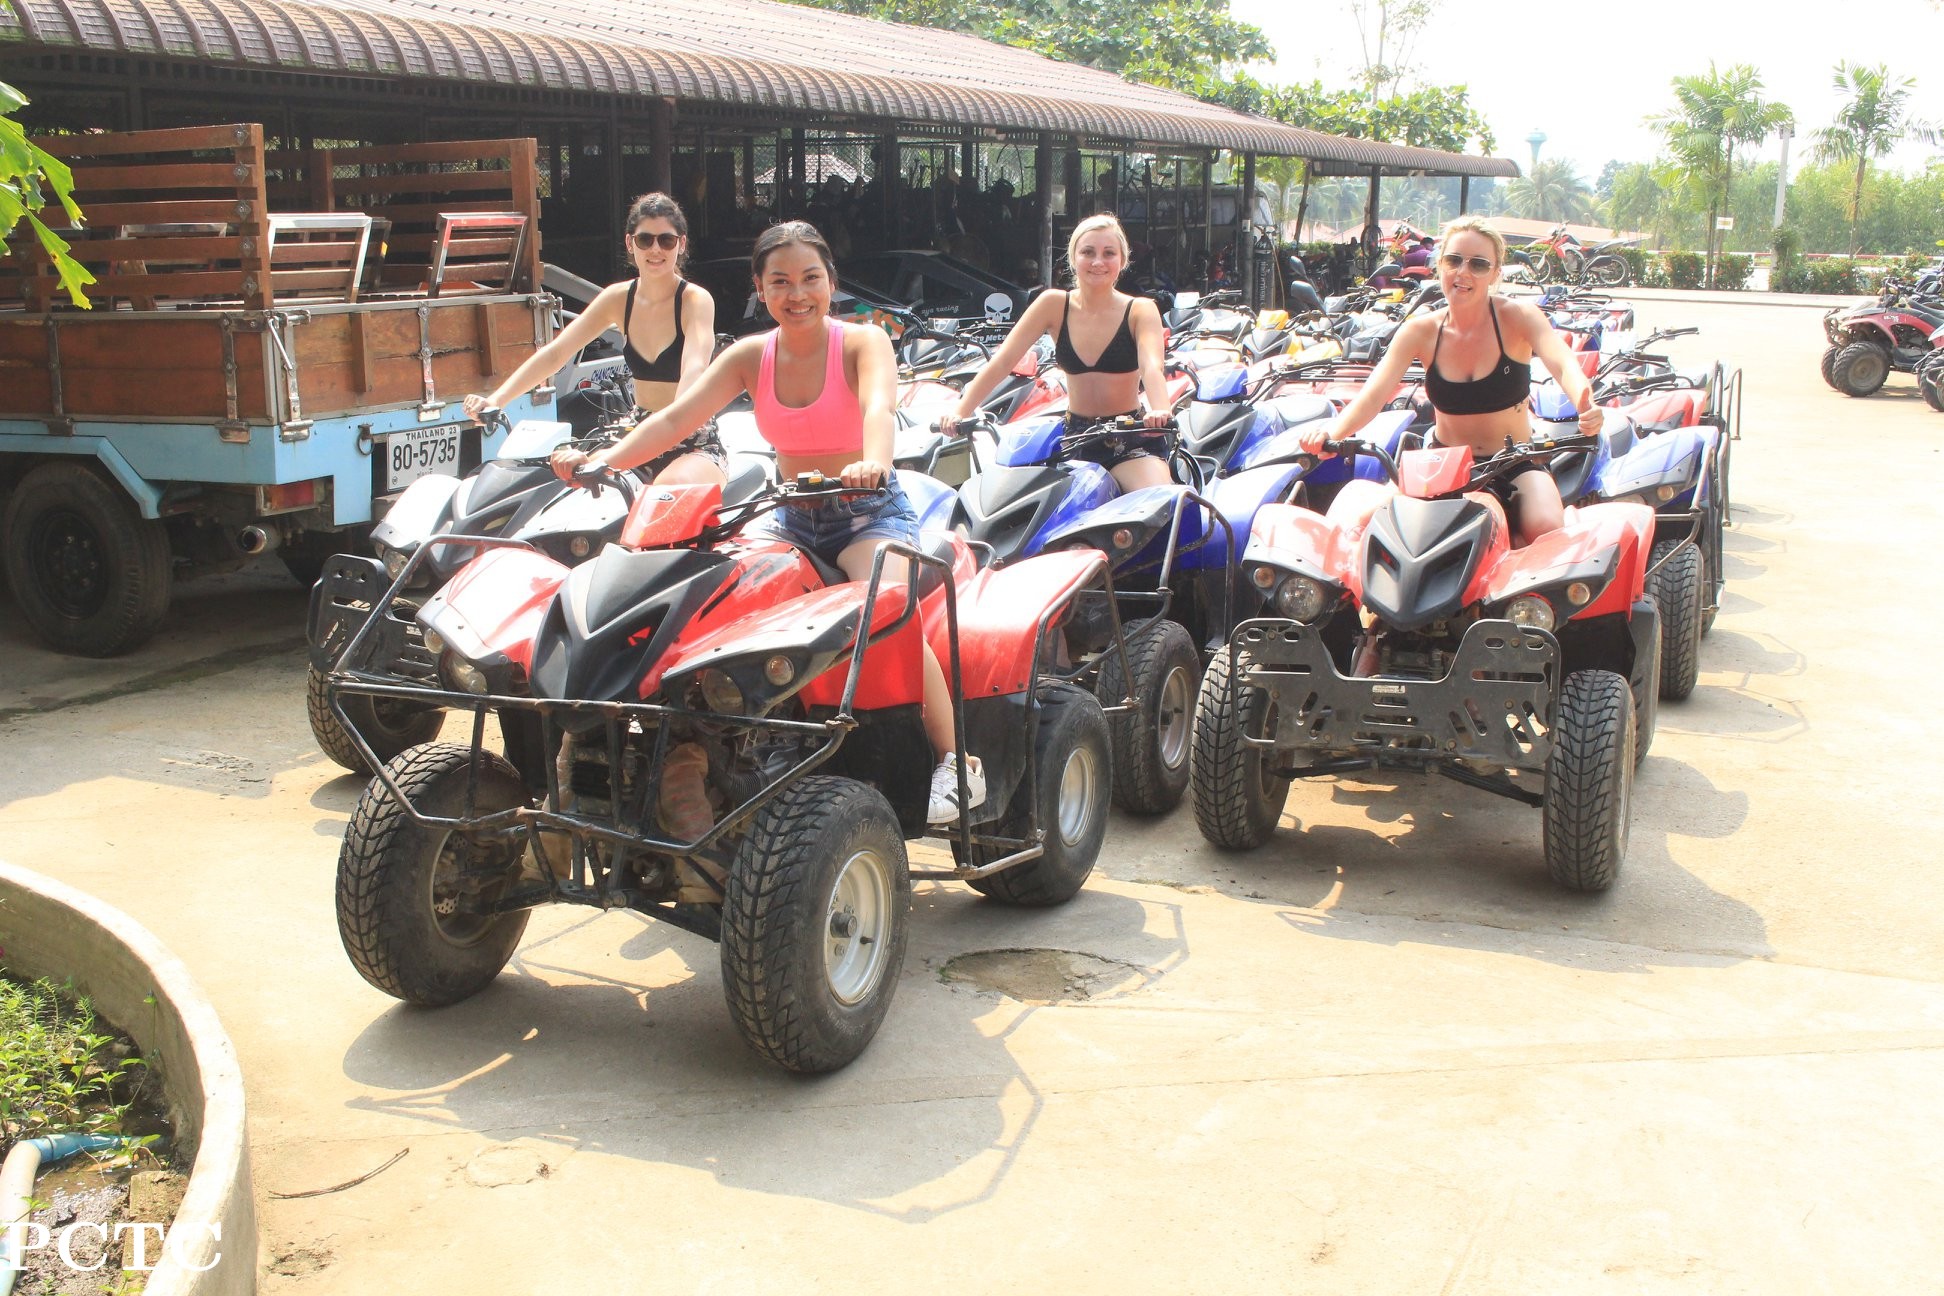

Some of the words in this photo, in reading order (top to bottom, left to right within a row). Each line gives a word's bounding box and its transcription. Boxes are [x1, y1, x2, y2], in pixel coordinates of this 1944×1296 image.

[406, 428, 445, 440] THAILAND
[449, 426, 457, 435] 23
[393, 437, 457, 471] 80-5735
